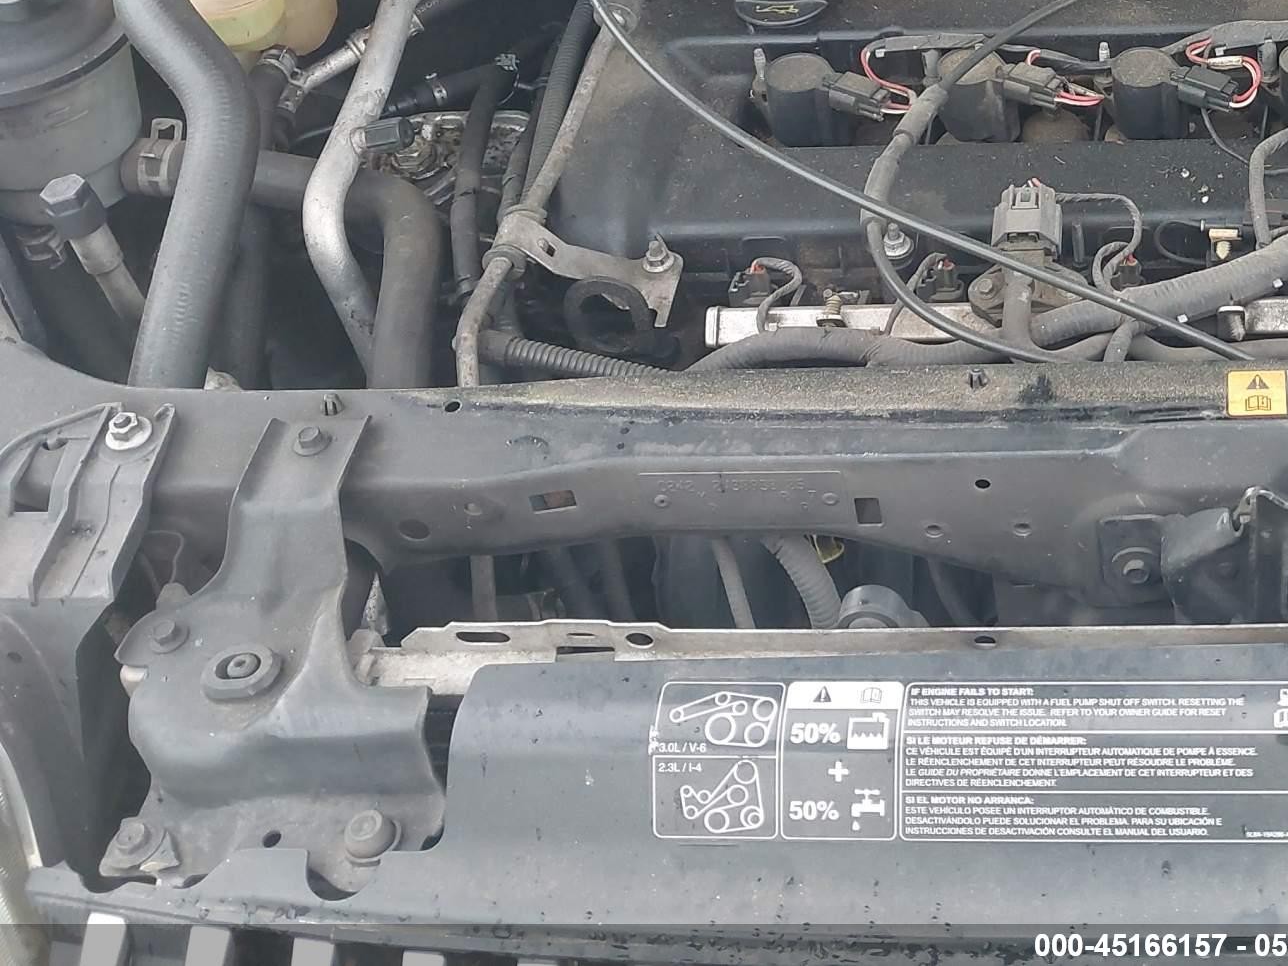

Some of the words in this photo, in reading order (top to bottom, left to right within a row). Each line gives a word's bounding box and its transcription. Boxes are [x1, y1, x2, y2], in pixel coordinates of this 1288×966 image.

[791, 722, 841, 744] 50%
[659, 743, 680, 753] 3.0L
[689, 743, 707, 753] V-6
[658, 762, 680, 773] 2.3L
[689, 762, 702, 773] I-4
[789, 801, 839, 821] 50%
